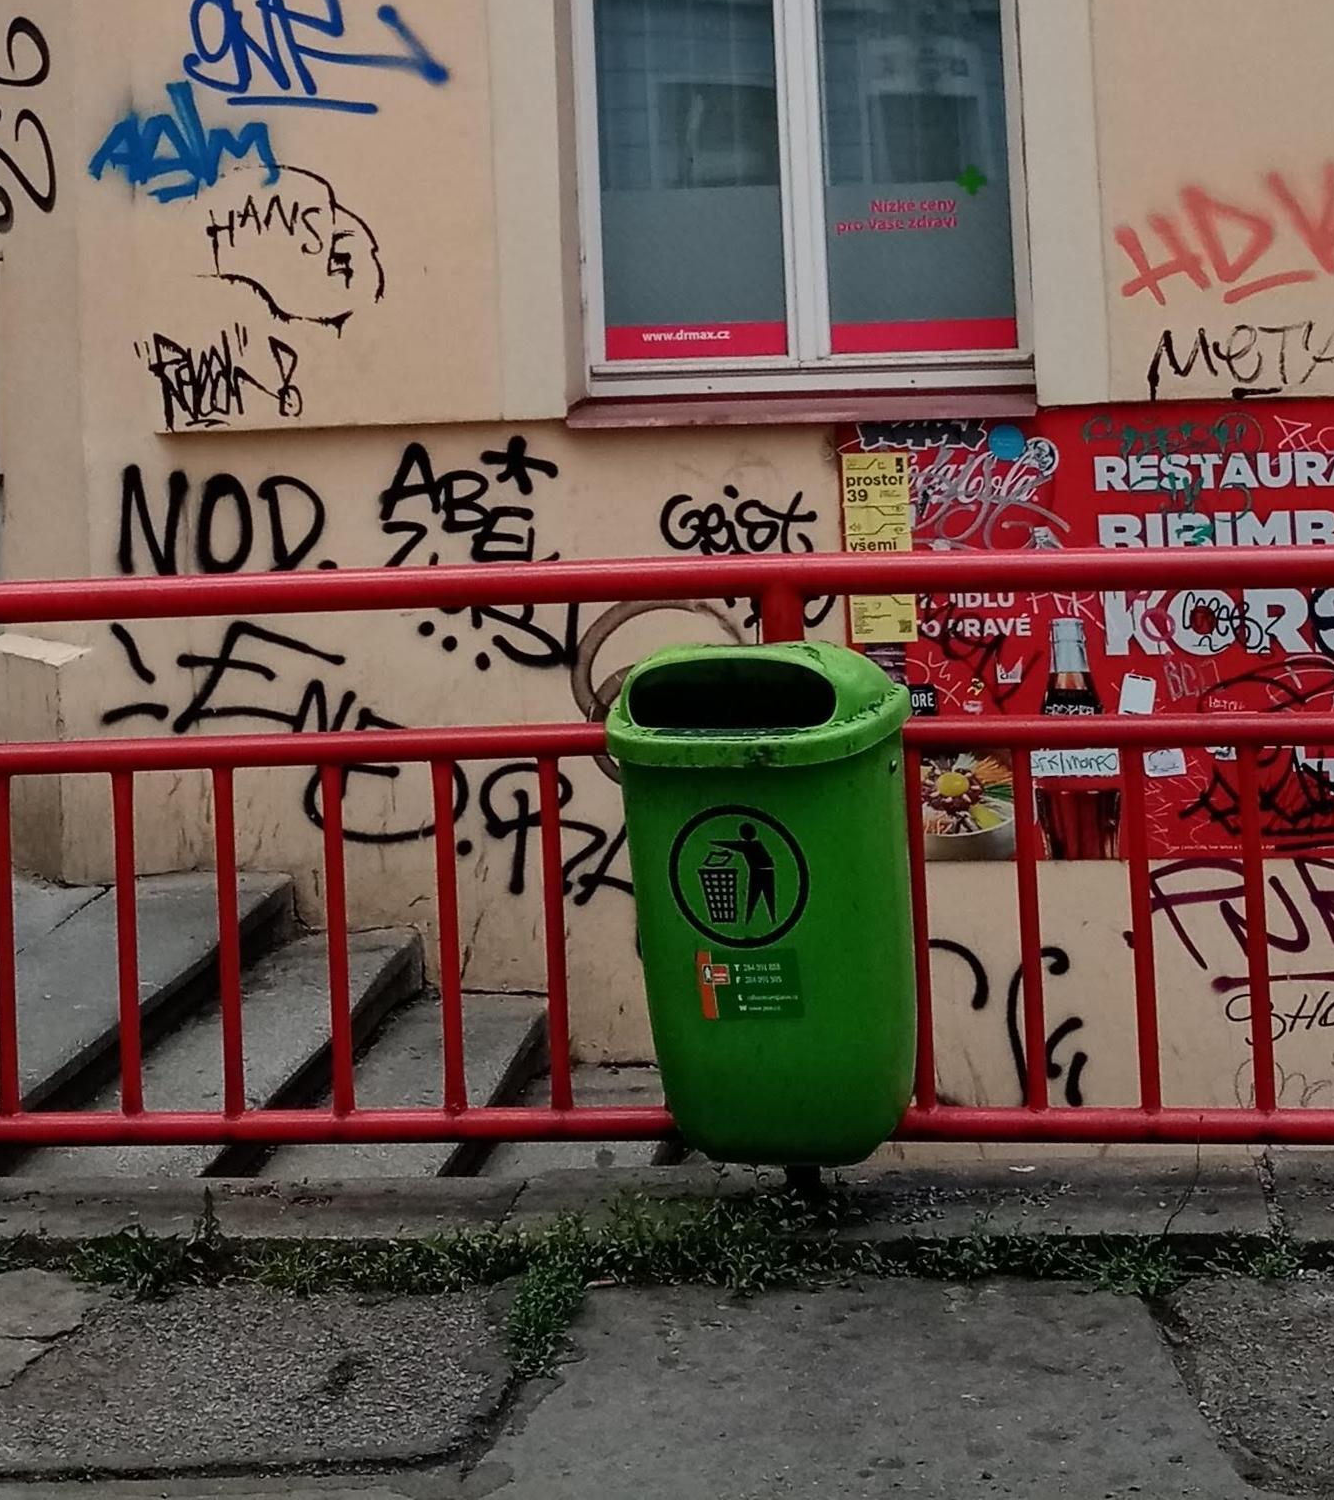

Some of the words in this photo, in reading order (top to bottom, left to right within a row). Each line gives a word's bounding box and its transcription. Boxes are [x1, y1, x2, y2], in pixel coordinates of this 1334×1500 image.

[641, 328, 731, 343] www.drmax.cz
[845, 474, 905, 488] prostor
[846, 488, 868, 503] 39
[911, 691, 935, 709] ORE
